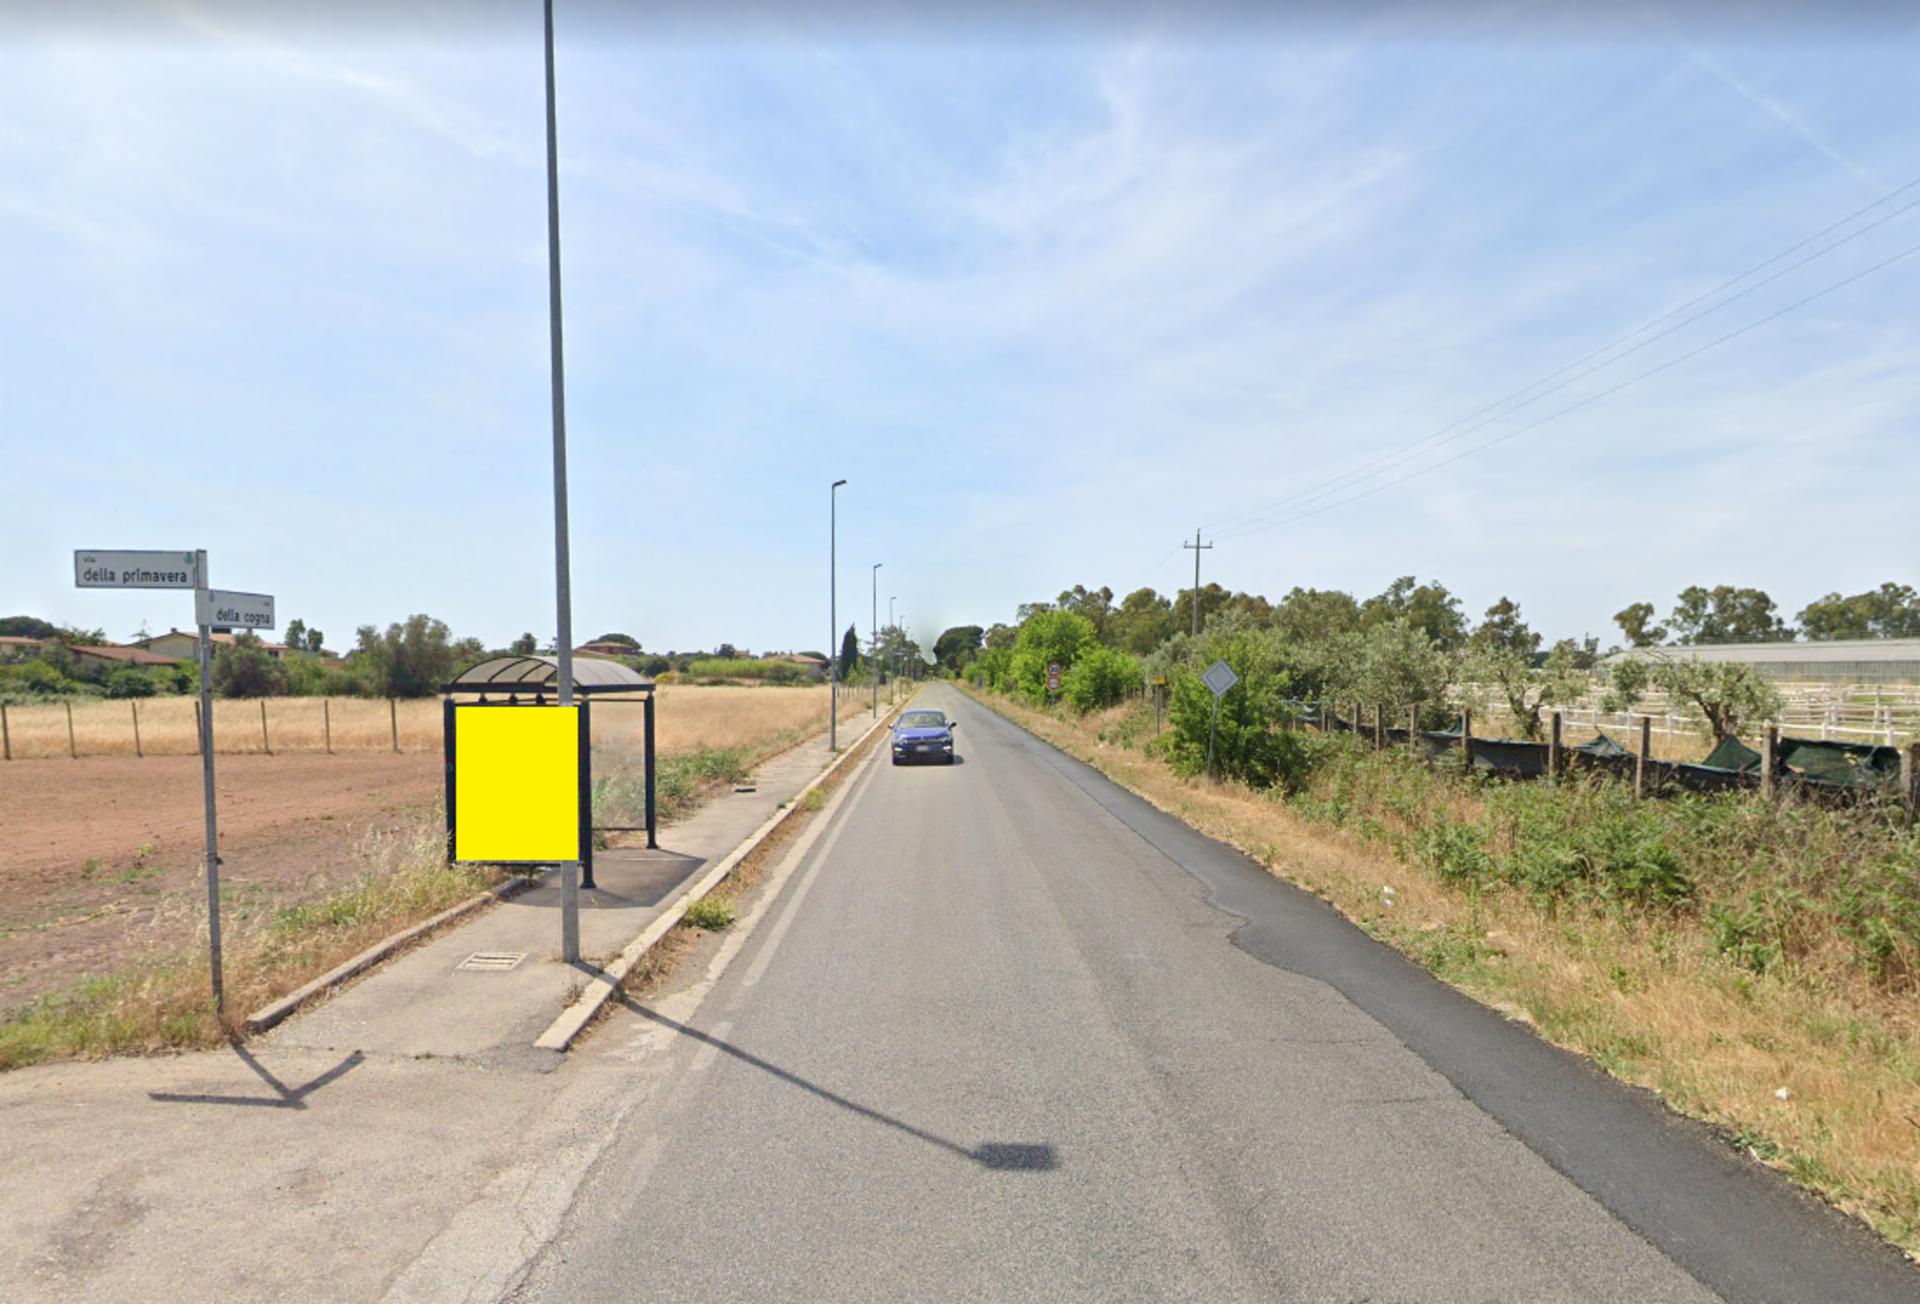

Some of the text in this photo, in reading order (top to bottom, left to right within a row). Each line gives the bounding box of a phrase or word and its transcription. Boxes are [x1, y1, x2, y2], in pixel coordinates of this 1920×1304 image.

[83, 567, 188, 584] della primavera
[216, 607, 240, 623] della
